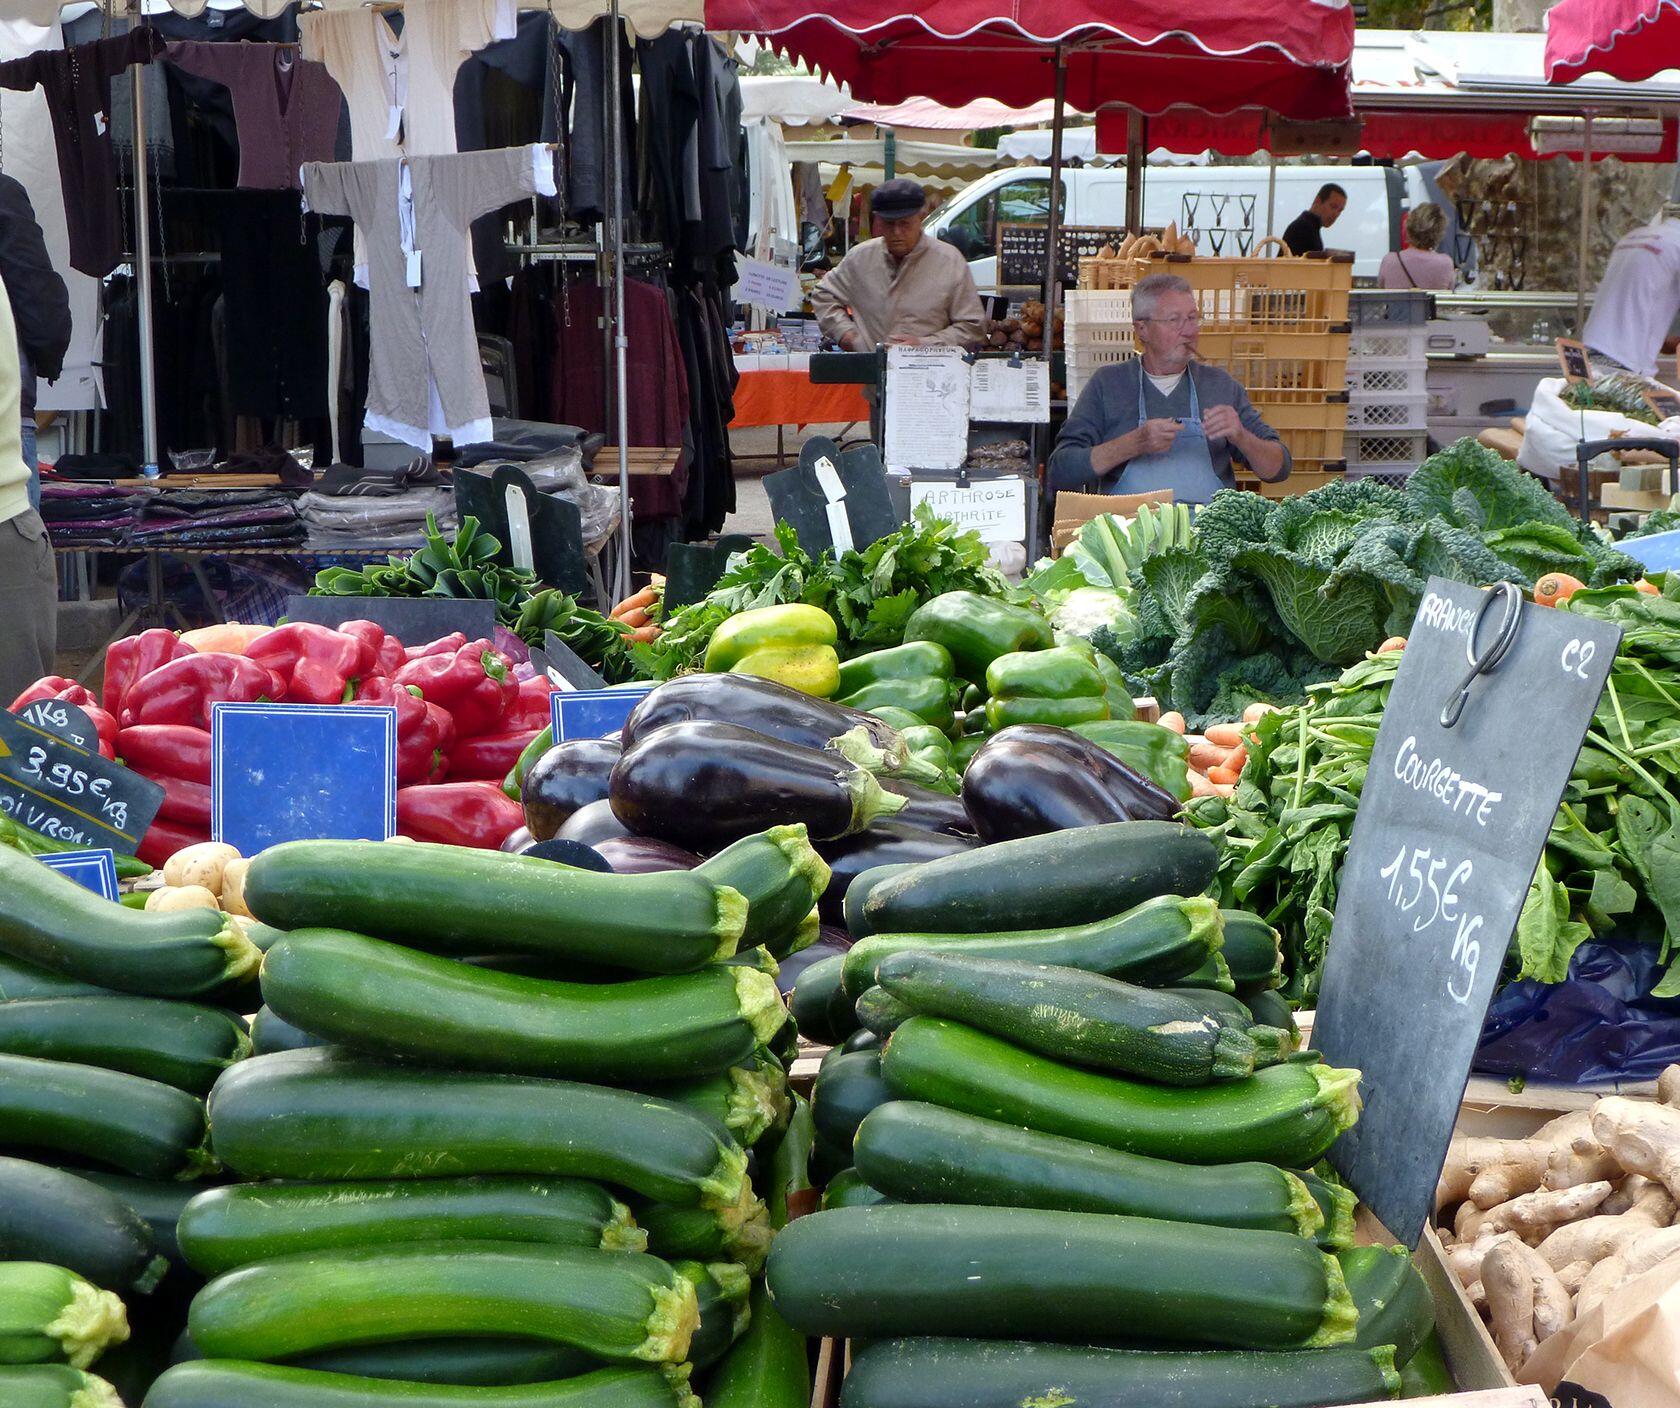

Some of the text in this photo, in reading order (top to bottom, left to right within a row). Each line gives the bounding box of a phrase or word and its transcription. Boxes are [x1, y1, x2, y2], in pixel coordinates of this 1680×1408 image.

[925, 489, 1015, 505] ARTHROSE
[1562, 638, 1596, 679] C2
[1394, 735, 1503, 827] COURGETTE
[1380, 845, 1473, 932] 1,55€
